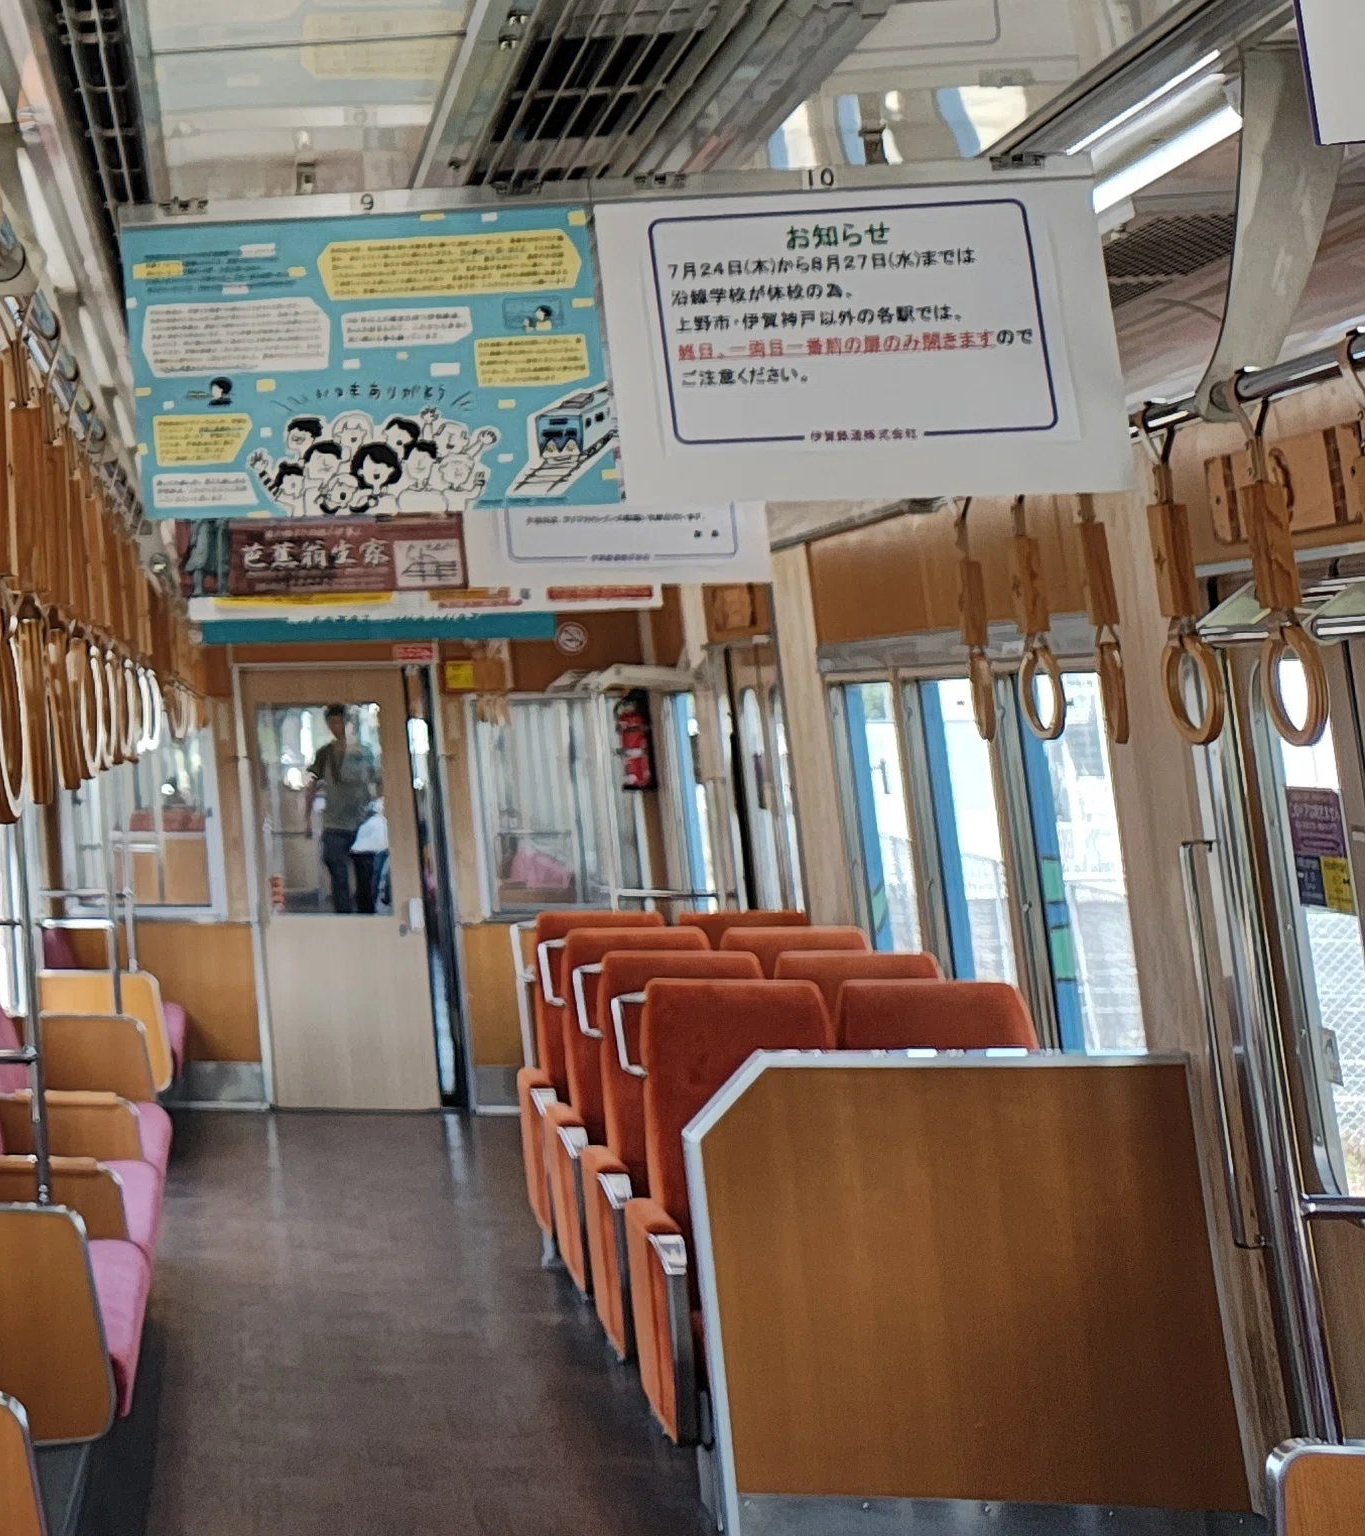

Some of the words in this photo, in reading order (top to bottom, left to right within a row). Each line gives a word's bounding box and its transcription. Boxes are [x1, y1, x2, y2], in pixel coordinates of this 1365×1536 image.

[808, 168, 834, 188] 10
[786, 222, 891, 250] お知らせ
